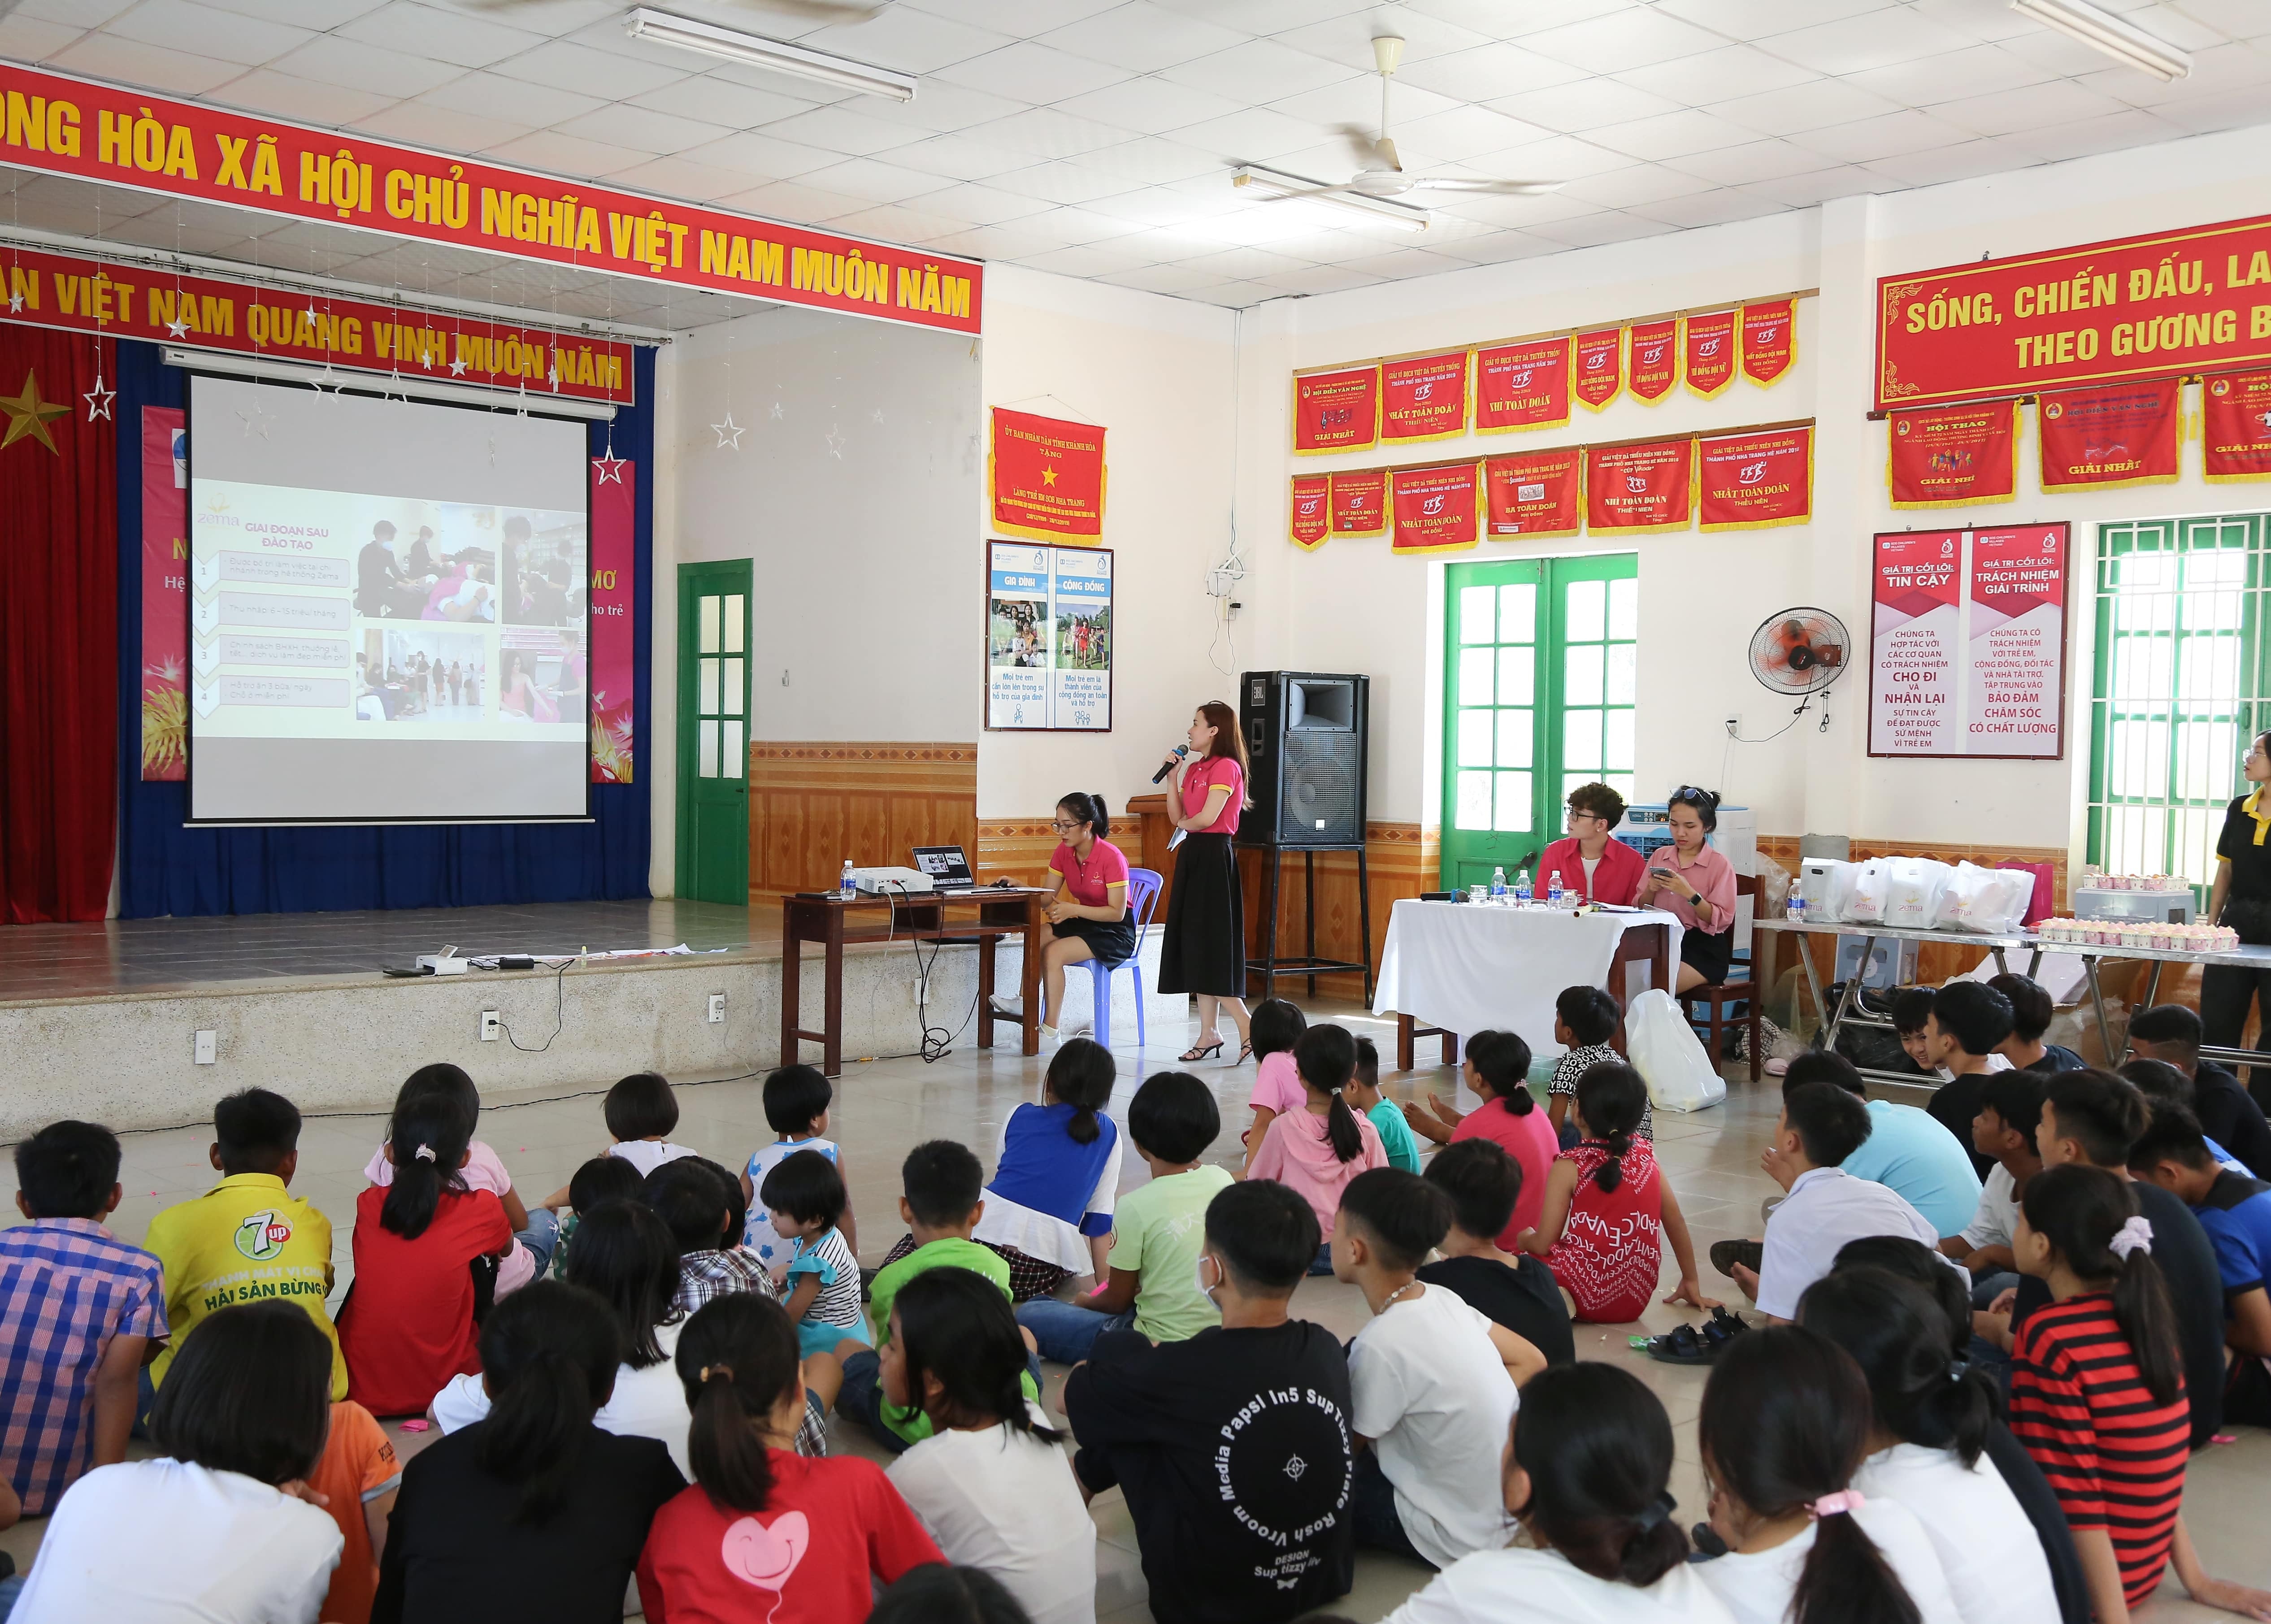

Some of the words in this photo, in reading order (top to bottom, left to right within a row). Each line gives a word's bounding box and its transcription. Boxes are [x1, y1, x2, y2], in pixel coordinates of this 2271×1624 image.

[0, 91, 81, 157] NG
[99, 108, 198, 180] HÒA
[215, 134, 283, 196] XÃ
[300, 149, 372, 217] HỘI
[386, 165, 469, 229] CHỦ
[482, 188, 602, 254] NGHĨA
[609, 211, 688, 273] VIỆT
[700, 229, 784, 287] NAM
[792, 248, 889, 305] MUÔN
[897, 264, 971, 318] NĂM
[1906, 287, 2002, 333] SỐNG,
[2014, 265, 2117, 318] CHIẾN
[2128, 251, 2213, 301] ĐẤU,
[2227, 250, 2271, 288] LA
[54, 272, 135, 325] VIỆT
[149, 287, 234, 336] NAM
[248, 304, 362, 354] QUANG
[372, 321, 446, 366] VINH
[457, 334, 544, 379] MUÔN
[555, 345, 622, 389] NĂM
[2015, 328, 2099, 369] THEO
[2111, 309, 2237, 356] GƯƠNG
[1926, 424, 1949, 432] HỘI
[1951, 421, 1987, 429] THAO
[1013, 430, 1024, 439] BAN
[1025, 432, 1040, 443] NHÂN
[1041, 435, 1052, 446] DÂN
[1066, 440, 1085, 451] KHÁNH
[1039, 448, 1062, 458] TẶNG
[2068, 462, 2101, 474] GIẢI
[1954, 474, 1976, 483] NHÌ
[1713, 487, 1738, 499] NHẤT
[1740, 486, 1763, 498] TOÀN
[1764, 482, 1789, 494] ĐOÀN
[1045, 495, 1055, 504] SOS
[1056, 497, 1066, 506] NHA
[1067, 499, 1085, 507] TRANG
[198, 513, 239, 526] zema
[245, 523, 267, 533] GIAI
[270, 525, 304, 537] ĐOẠN
[307, 527, 329, 538] SAU
[262, 536, 287, 547] ĐÀO
[290, 539, 313, 551] TẠO
[1882, 565, 1899, 573] GIÁ
[1902, 566, 1913, 574] TRỊ
[1915, 562, 1935, 572] CỐT
[1983, 559, 1999, 568] GIÁ
[2002, 560, 2014, 568] TRỊ
[2016, 556, 2035, 566] CỐT
[1004, 576, 1016, 586] GIA
[1018, 575, 1035, 587] ĐÌNH
[1886, 576, 1911, 587] TIN
[1916, 573, 1950, 588] CẬY
[1976, 570, 2017, 582] TRÁCH
[2020, 569, 2059, 582] NHIỆM
[1063, 579, 1082, 592] CỘNG
[1085, 579, 1105, 592] ĐỒNG
[1985, 582, 2009, 594] GIẢI
[2012, 581, 2049, 593] TRÌNH
[202, 610, 207, 618] 2
[608, 603, 624, 616] trẻ
[1891, 641, 1907, 649] HỢP
[1925, 639, 1939, 647] VỚI
[2015, 638, 2041, 648] NHIỆM
[201, 651, 207, 660] 3
[1888, 650, 1903, 658] CÁC
[1992, 649, 2005, 657] VỚI
[2007, 648, 2020, 657] TRẺ
[1881, 660, 1892, 668] CÓ
[1922, 660, 1948, 669] NHIỆM
[1975, 660, 1996, 669] CỘNG
[2024, 659, 2038, 667] ĐỐI
[1893, 672, 1920, 682] CHO
[1923, 672, 1937, 682] ĐI
[1996, 670, 2012, 678] NHÀ
[1909, 682, 1919, 690] VÀ
[1984, 681, 1997, 690] TẬP
[1254, 686, 1264, 699] JBL
[1885, 691, 1922, 706] NHẬN
[1925, 693, 1945, 706] LẠI
[1988, 690, 2010, 703] BẢO
[2013, 690, 2039, 703] ĐẢM
[1893, 709, 1905, 717] SỰ
[1921, 708, 1936, 717] CẬY
[1984, 707, 2017, 718] CHĂM
[2019, 707, 2041, 718] SÓC
[1887, 718, 1898, 726] ĐỂ
[1899, 720, 1915, 728] ĐẠT
[1917, 720, 1941, 728] ĐƯỢC
[1969, 721, 1984, 733] CÓ
[1986, 721, 2015, 733] CHẤT
[2017, 722, 2056, 736] LƯỢNG
[1895, 729, 1906, 737] SỨ
[1908, 729, 1932, 738] MỆNH
[1904, 738, 1918, 747] TRẺ
[204, 1288, 234, 1311] HẢI
[239, 1280, 276, 1300] SẢN
[280, 1278, 321, 1295] BỪNG
[1215, 1445, 1236, 1501] Media
[1233, 1505, 1287, 1546] Vroom
[1275, 1549, 1310, 1566] DESIGN
[1254, 1566, 1278, 1579] Sup
